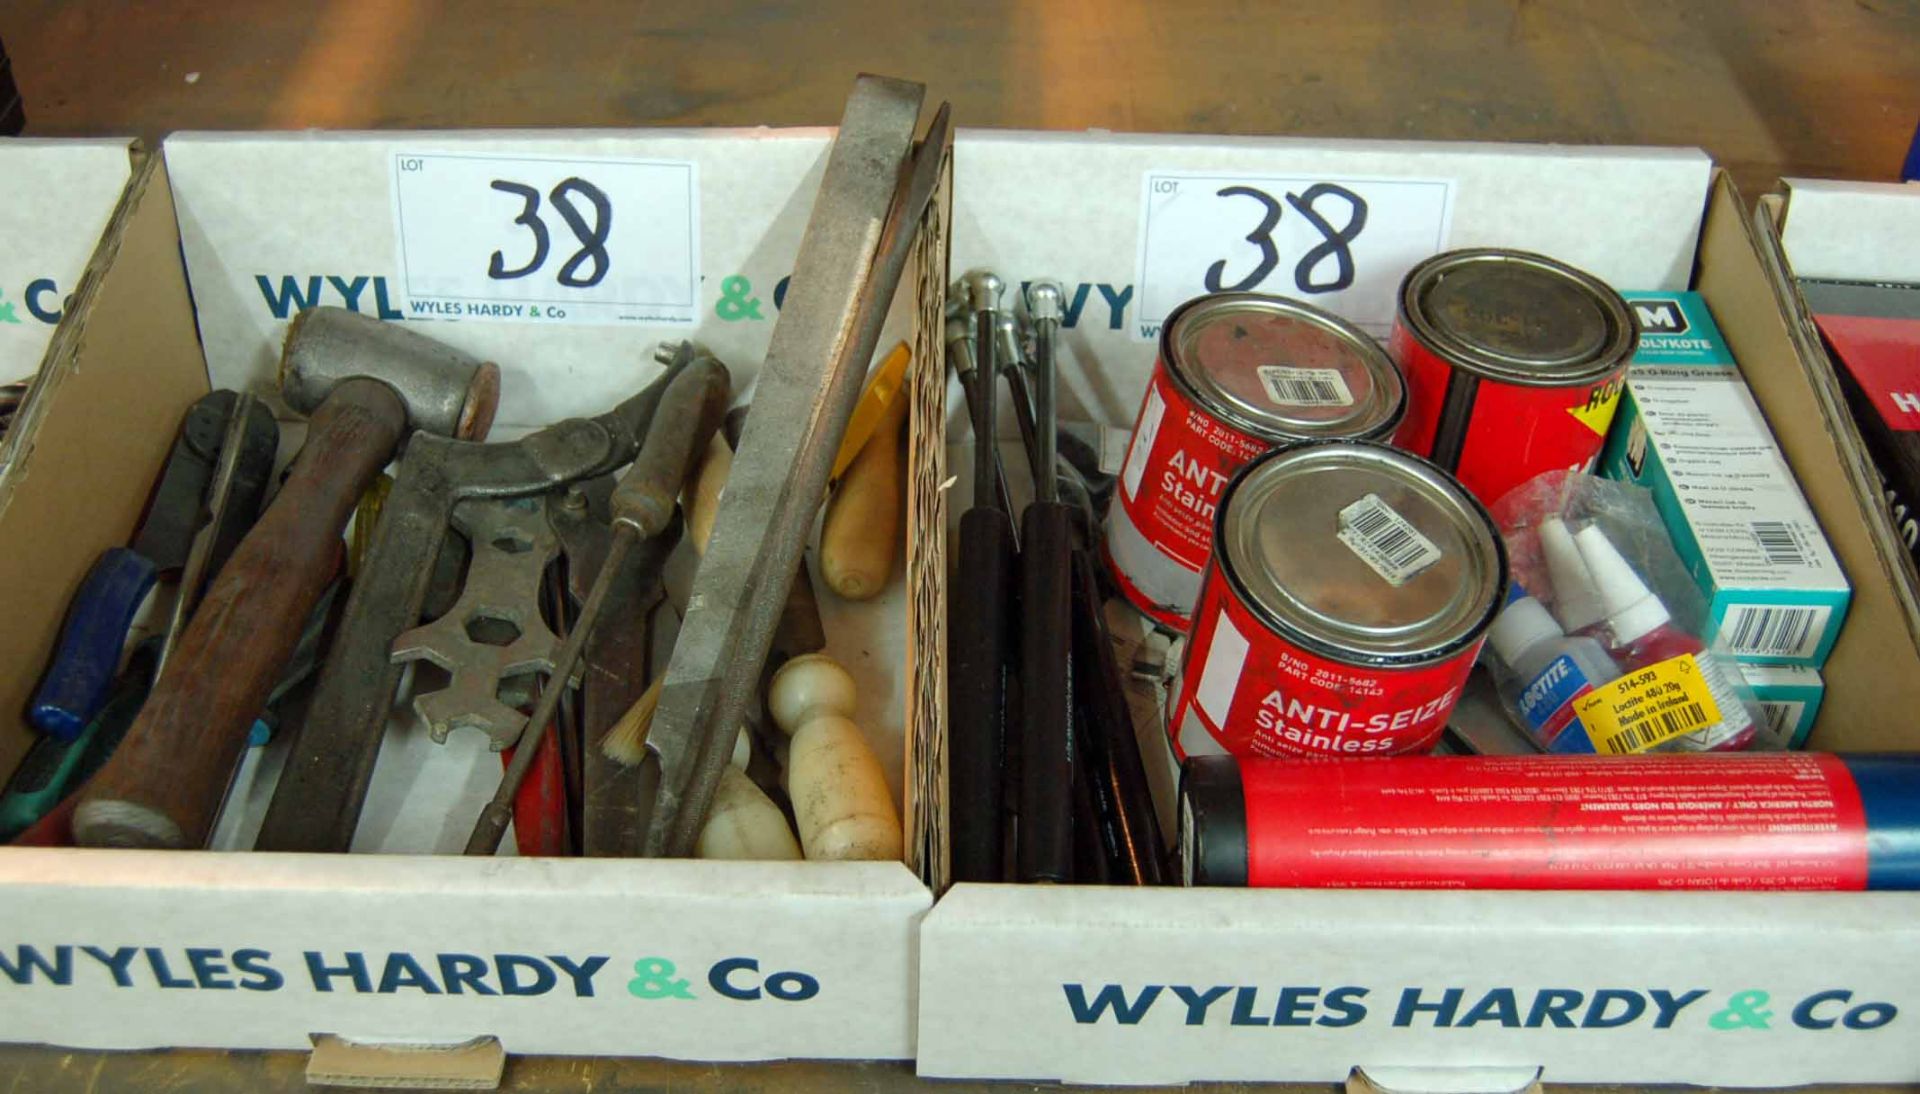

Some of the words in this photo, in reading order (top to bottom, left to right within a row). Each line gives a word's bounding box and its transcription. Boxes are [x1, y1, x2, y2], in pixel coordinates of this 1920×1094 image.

[401, 160, 424, 171] LOT
[1154, 181, 1178, 193] LOT
[488, 177, 612, 288] 38
[1204, 183, 1369, 294] 38
[411, 301, 462, 315] WYLES
[468, 304, 522, 317] HARDY
[529, 306, 541, 318] &
[547, 307, 566, 319] Co
[1278, 661, 1308, 680] PART
[1280, 652, 1308, 671] B/NO
[1518, 658, 1569, 715] LOCTITE
[1617, 670, 1657, 694] 514-593
[1261, 686, 1458, 734] ANTI-SEIZE
[1613, 695, 1644, 714] Loctite
[1618, 710, 1645, 727] Made
[1647, 704, 1657, 715] in
[1657, 692, 1689, 710] Ireland
[1254, 708, 1393, 753] Stainless
[1733, 801, 1758, 809] ONLY
[1759, 800, 1799, 809] AMERICA
[0, 944, 284, 992] WYLES
[303, 951, 610, 997] HARDY
[627, 957, 699, 999] &
[708, 957, 820, 1001] Co
[1063, 983, 1372, 1028] WYLES
[1392, 987, 1710, 1029] HARDY
[1708, 989, 1776, 1030] &
[1791, 989, 1899, 1031] Co
